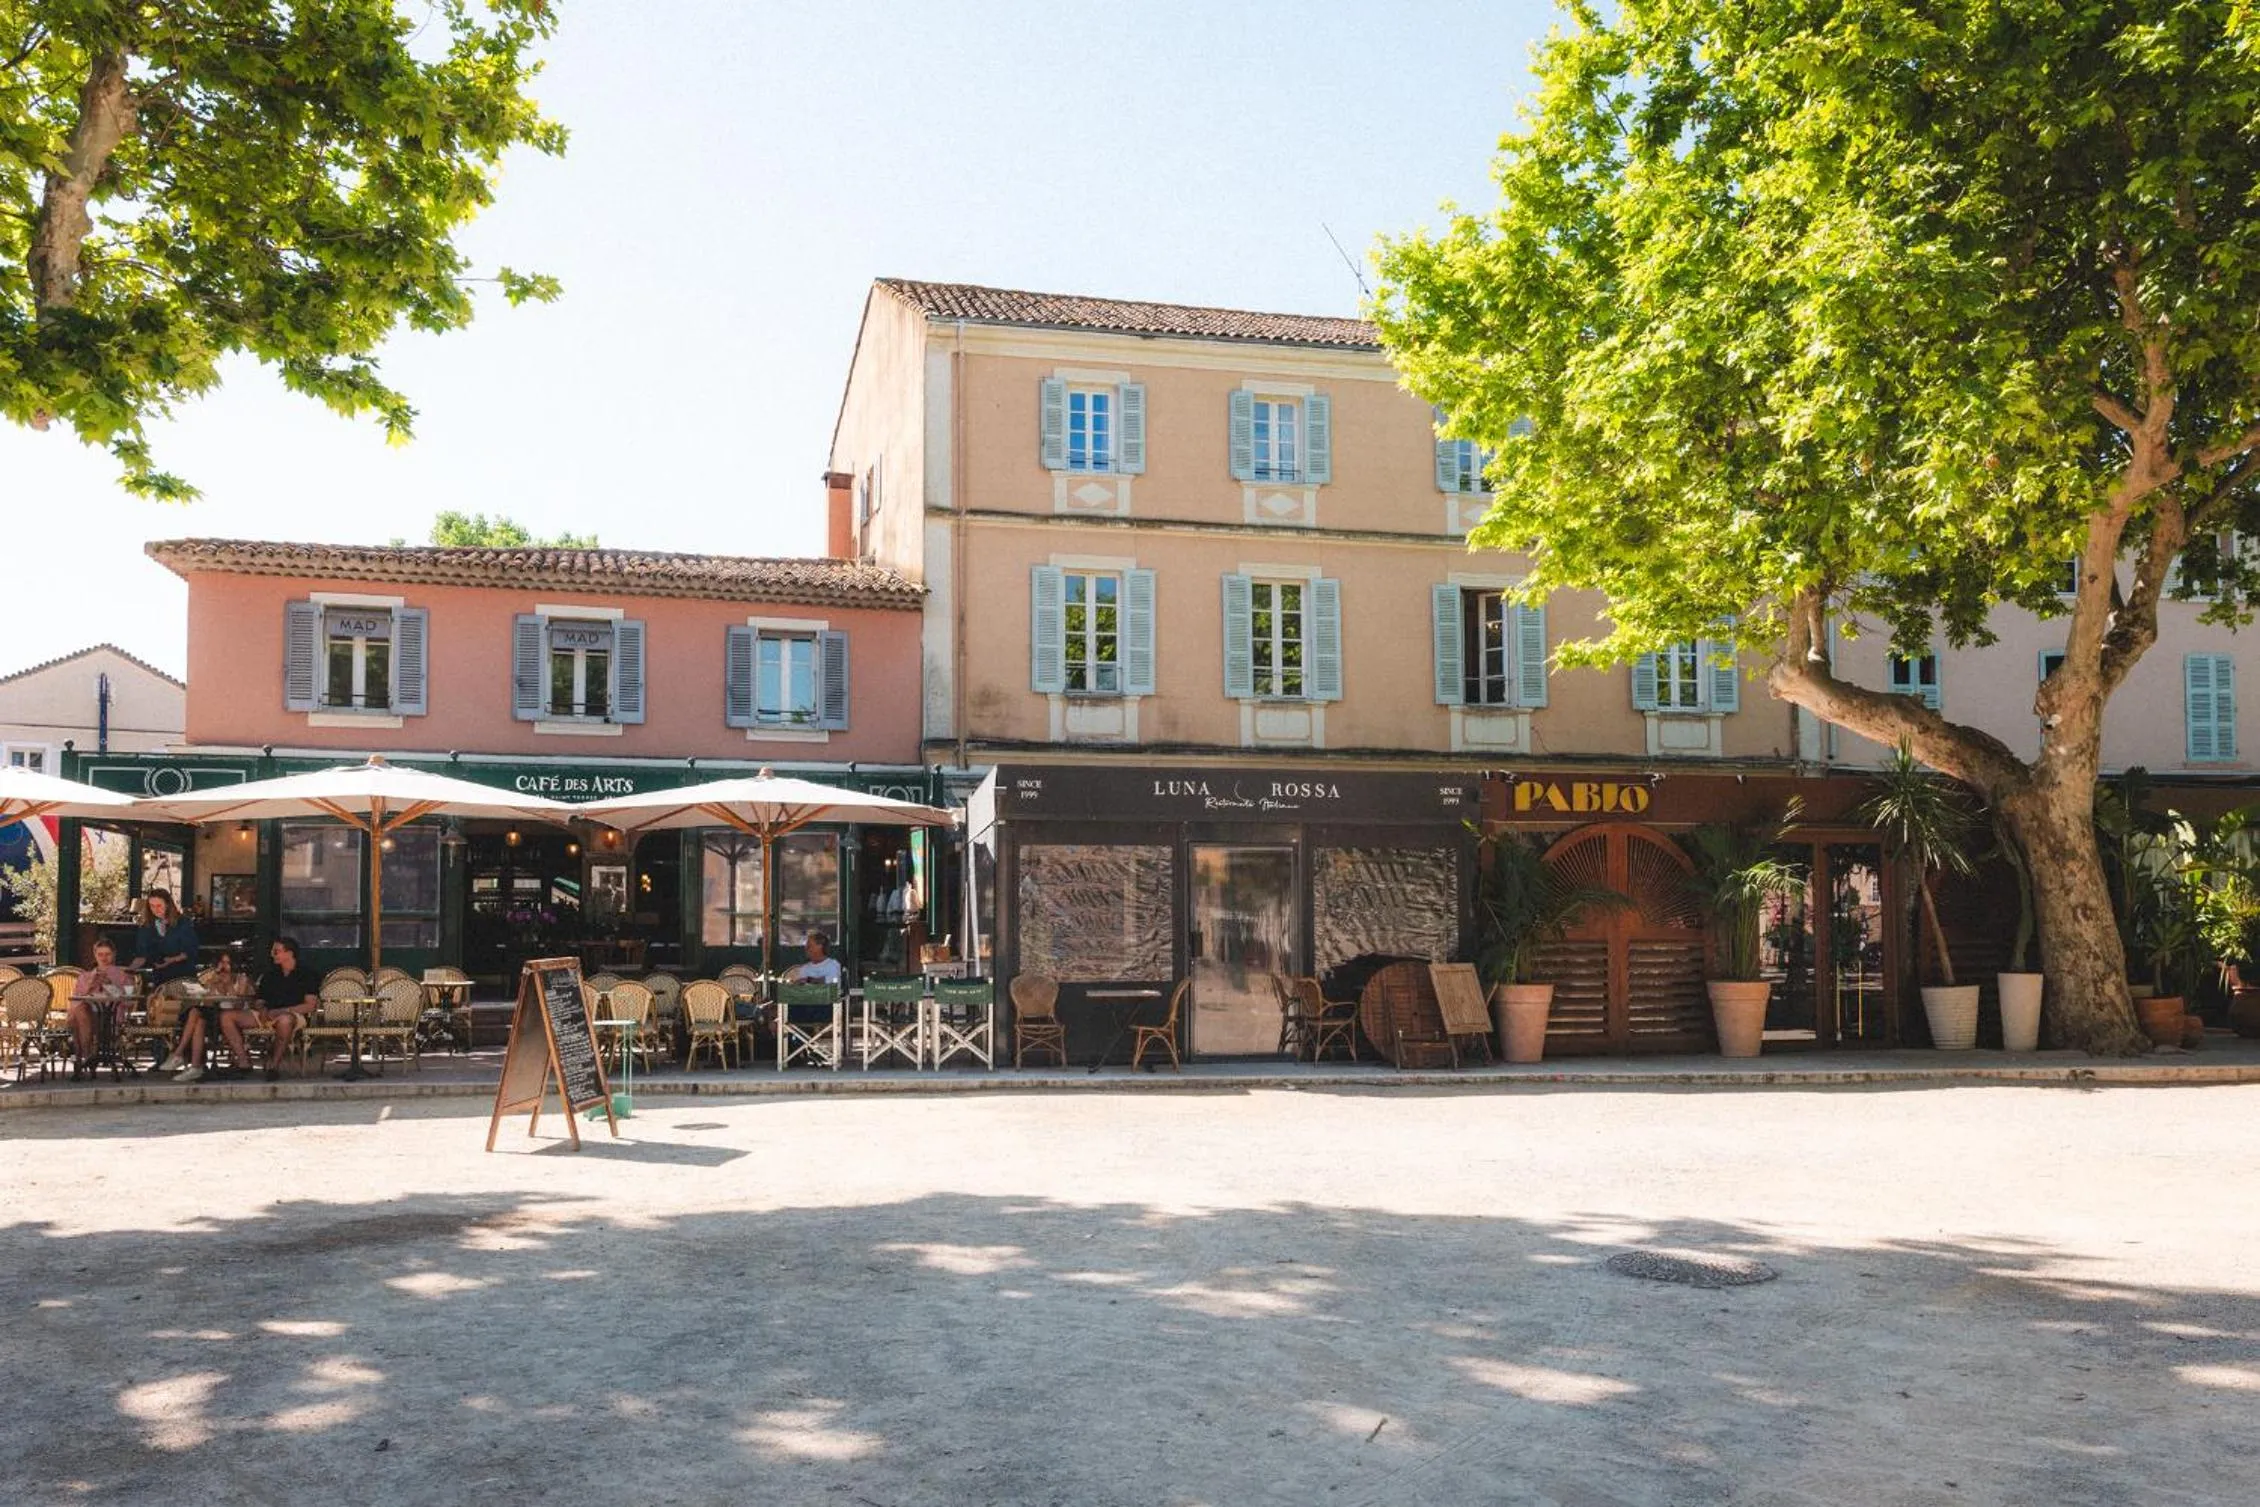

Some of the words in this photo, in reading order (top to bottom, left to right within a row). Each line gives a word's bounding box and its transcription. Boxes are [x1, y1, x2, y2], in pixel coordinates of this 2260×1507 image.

[340, 619, 377, 631] MAD
[565, 631, 600, 644] MAD
[515, 775, 561, 791] CAFÉ
[564, 778, 588, 791] DES
[592, 775, 634, 793] ARTS
[1016, 780, 1042, 789] SINCE
[1154, 781, 1210, 796] LUNA
[1272, 783, 1341, 798] ROSSA
[1439, 788, 1463, 796] SINCE
[1514, 780, 1649, 813] PABLO
